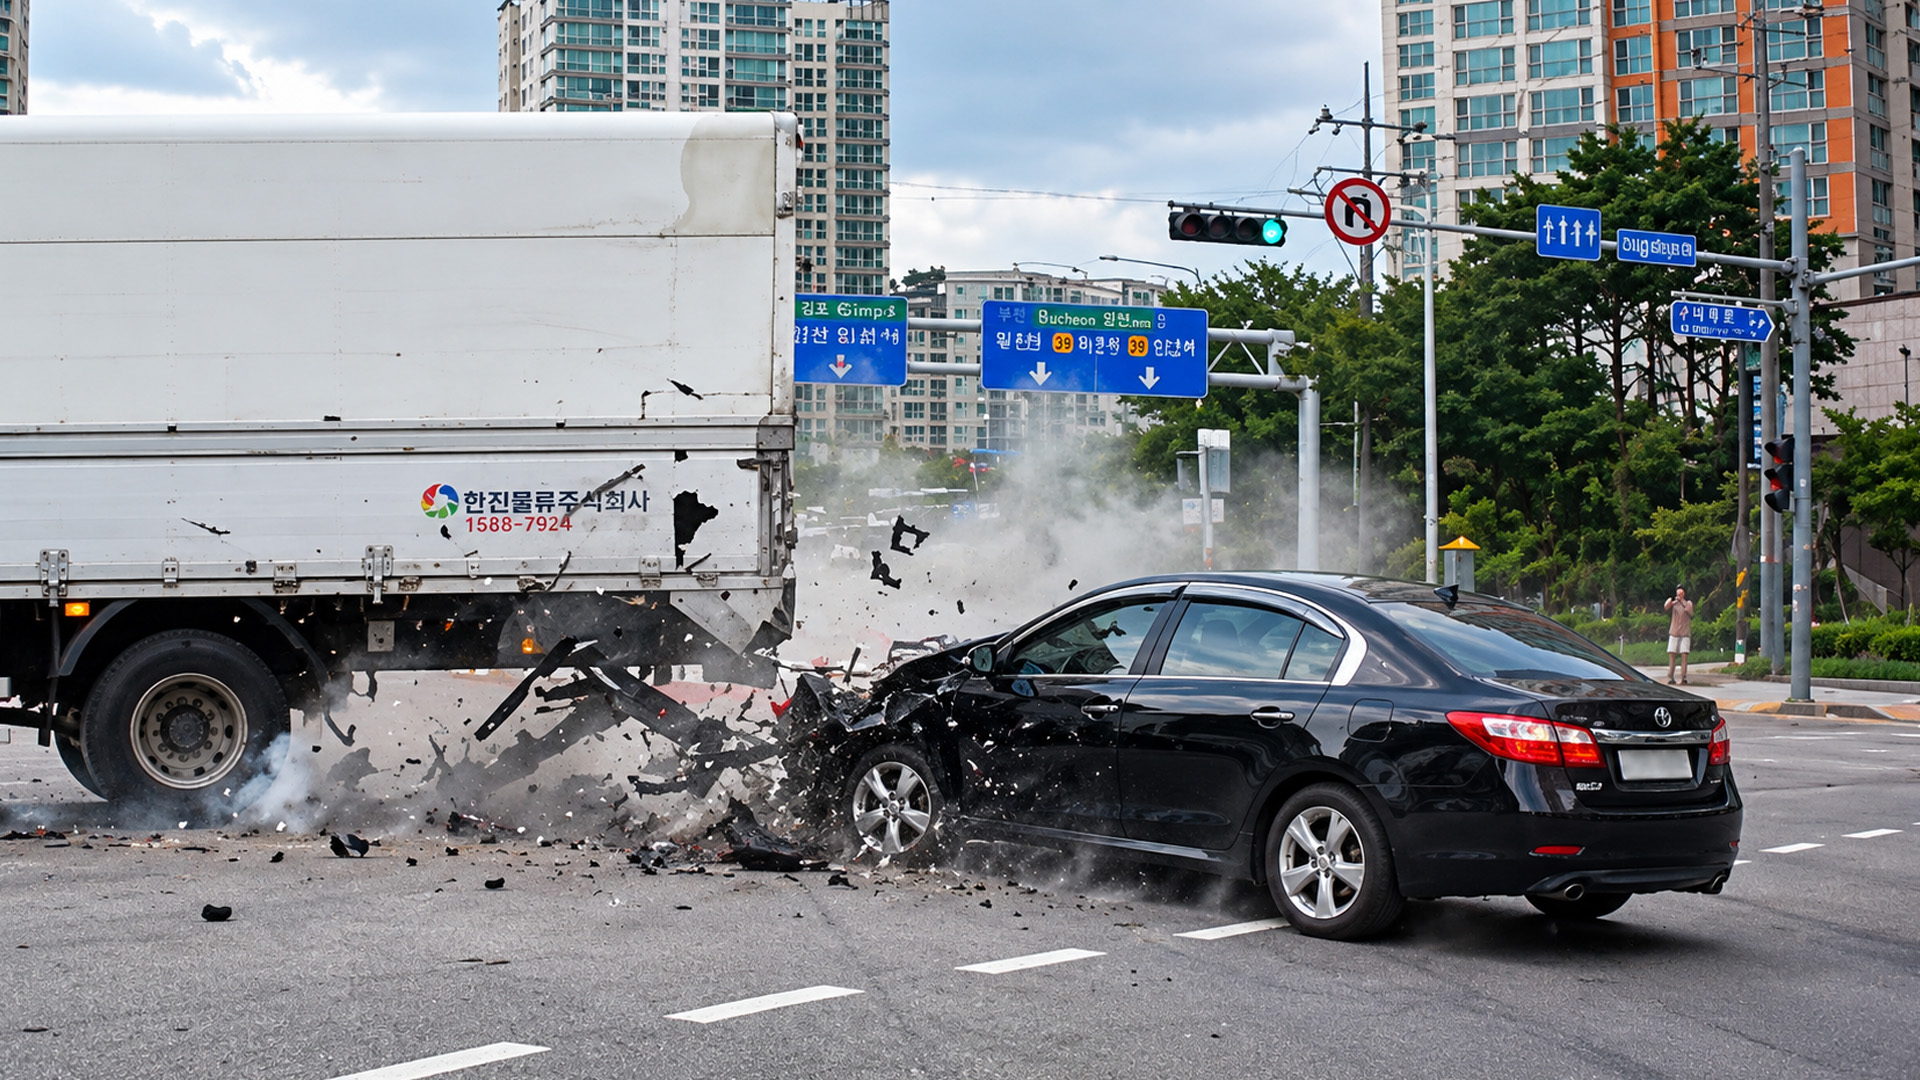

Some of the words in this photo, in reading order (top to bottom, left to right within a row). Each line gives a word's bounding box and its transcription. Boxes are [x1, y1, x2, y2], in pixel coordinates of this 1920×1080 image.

[801, 301, 829, 316] 김포
[1038, 309, 1096, 326] Bucheon
[1055, 335, 1072, 350] 39
[1129, 339, 1146, 354] 39
[466, 516, 573, 533] 1588-7924
